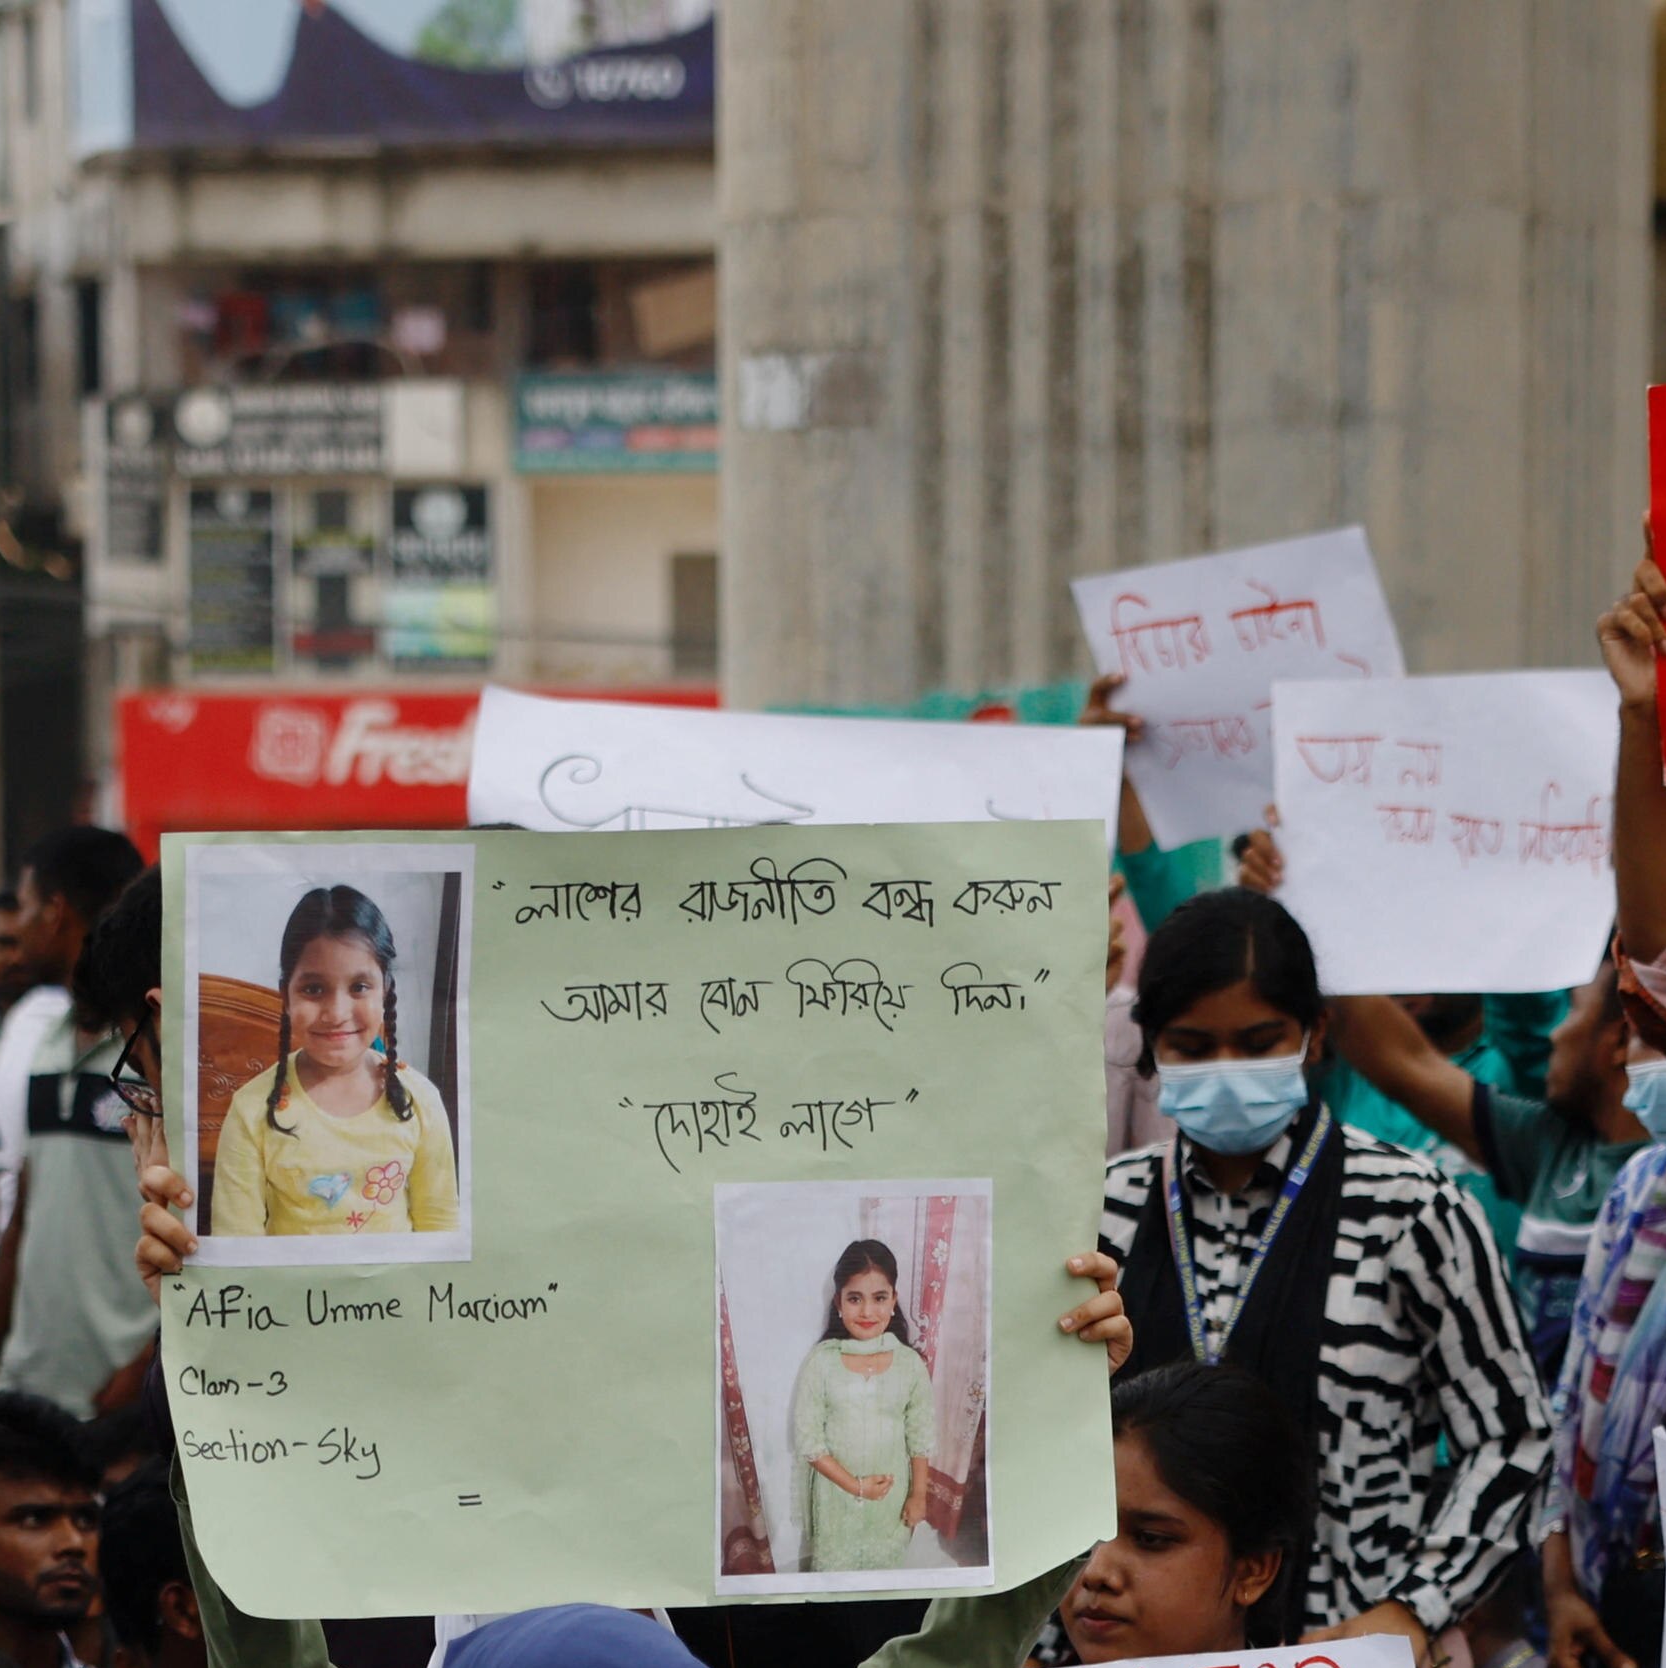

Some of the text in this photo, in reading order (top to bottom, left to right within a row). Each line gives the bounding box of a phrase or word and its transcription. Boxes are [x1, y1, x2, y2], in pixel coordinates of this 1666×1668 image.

[679, 856, 848, 925] রাজনীতি
[862, 880, 935, 928] বন্ধ
[952, 880, 1062, 916] করুন
[540, 979, 670, 1024] আমার
[700, 977, 774, 1034] বোন
[306, 1288, 404, 1326] Umme
